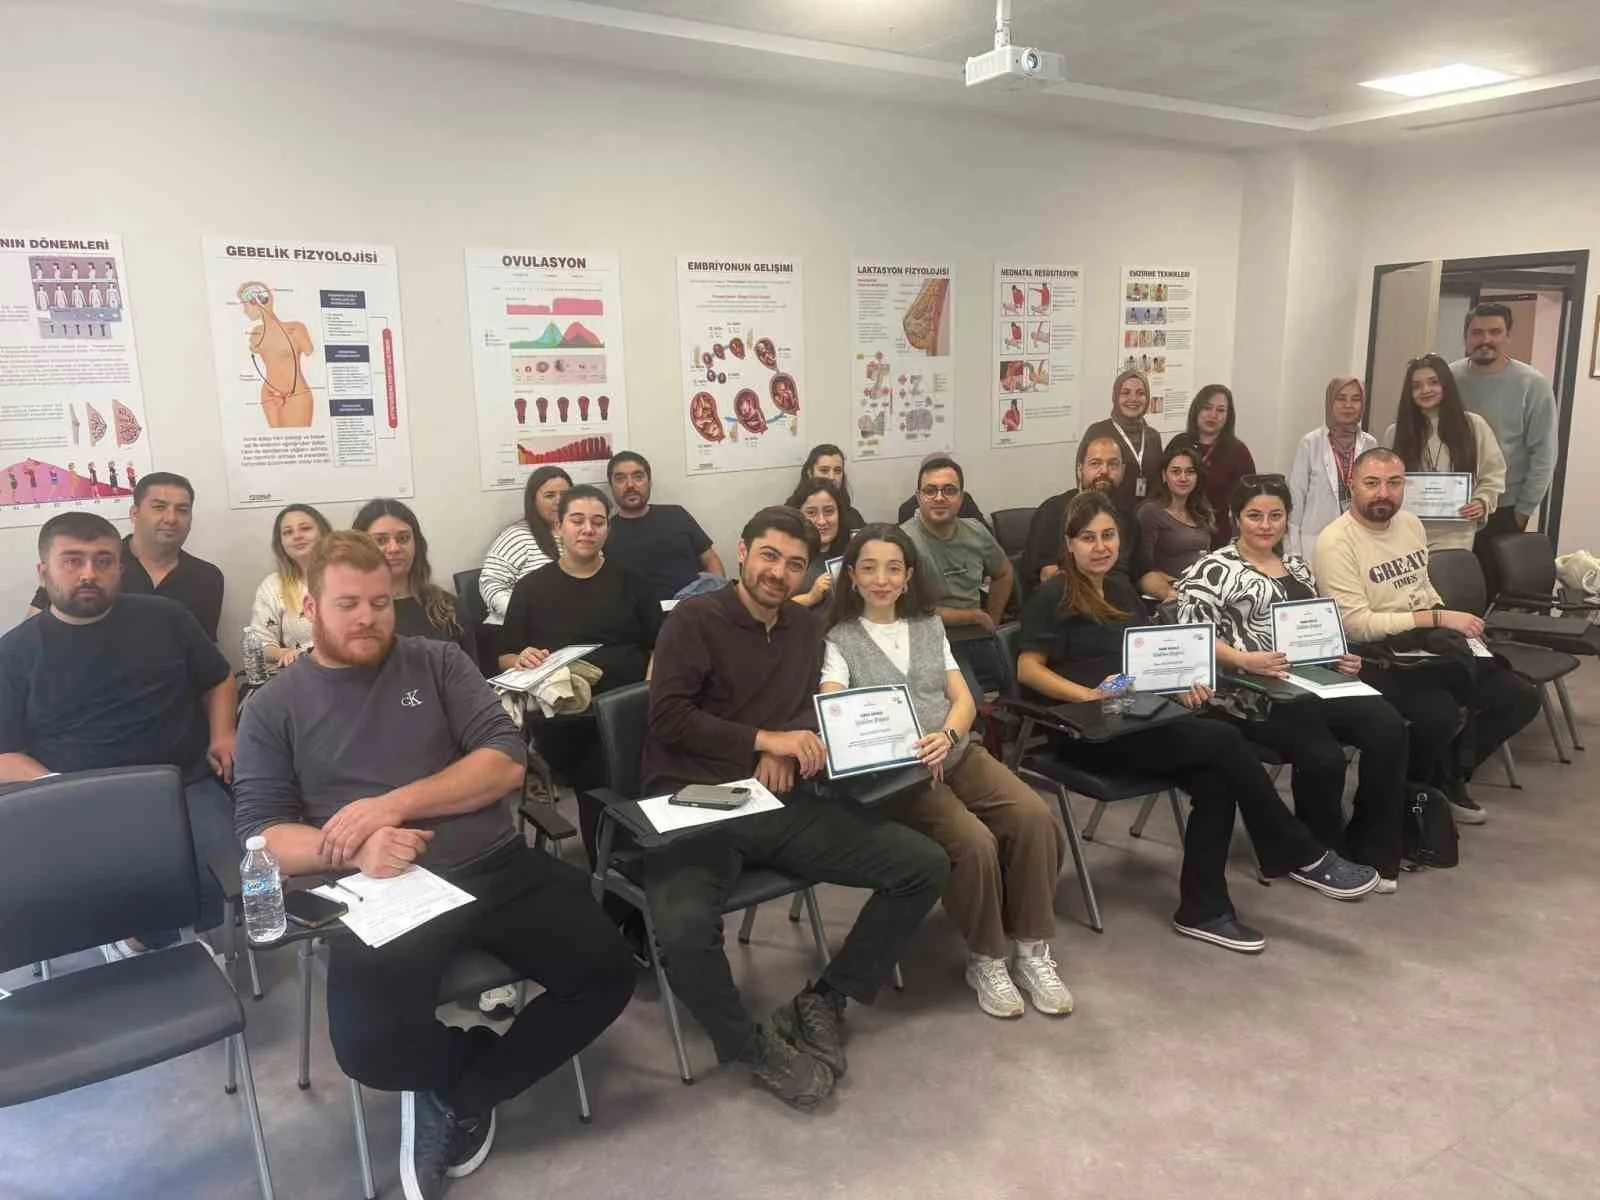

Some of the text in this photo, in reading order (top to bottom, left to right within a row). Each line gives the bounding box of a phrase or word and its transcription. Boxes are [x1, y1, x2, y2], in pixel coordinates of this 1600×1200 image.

[29, 237, 110, 250] DÖNEMLERİ
[226, 245, 378, 264] GEBELİK FİZYOLOJİSİ
[502, 255, 586, 269] OVULASYON
[857, 265, 903, 275] LAKTASYON
[1369, 549, 1426, 584] GREAT
[1393, 575, 1418, 589] TIMES
